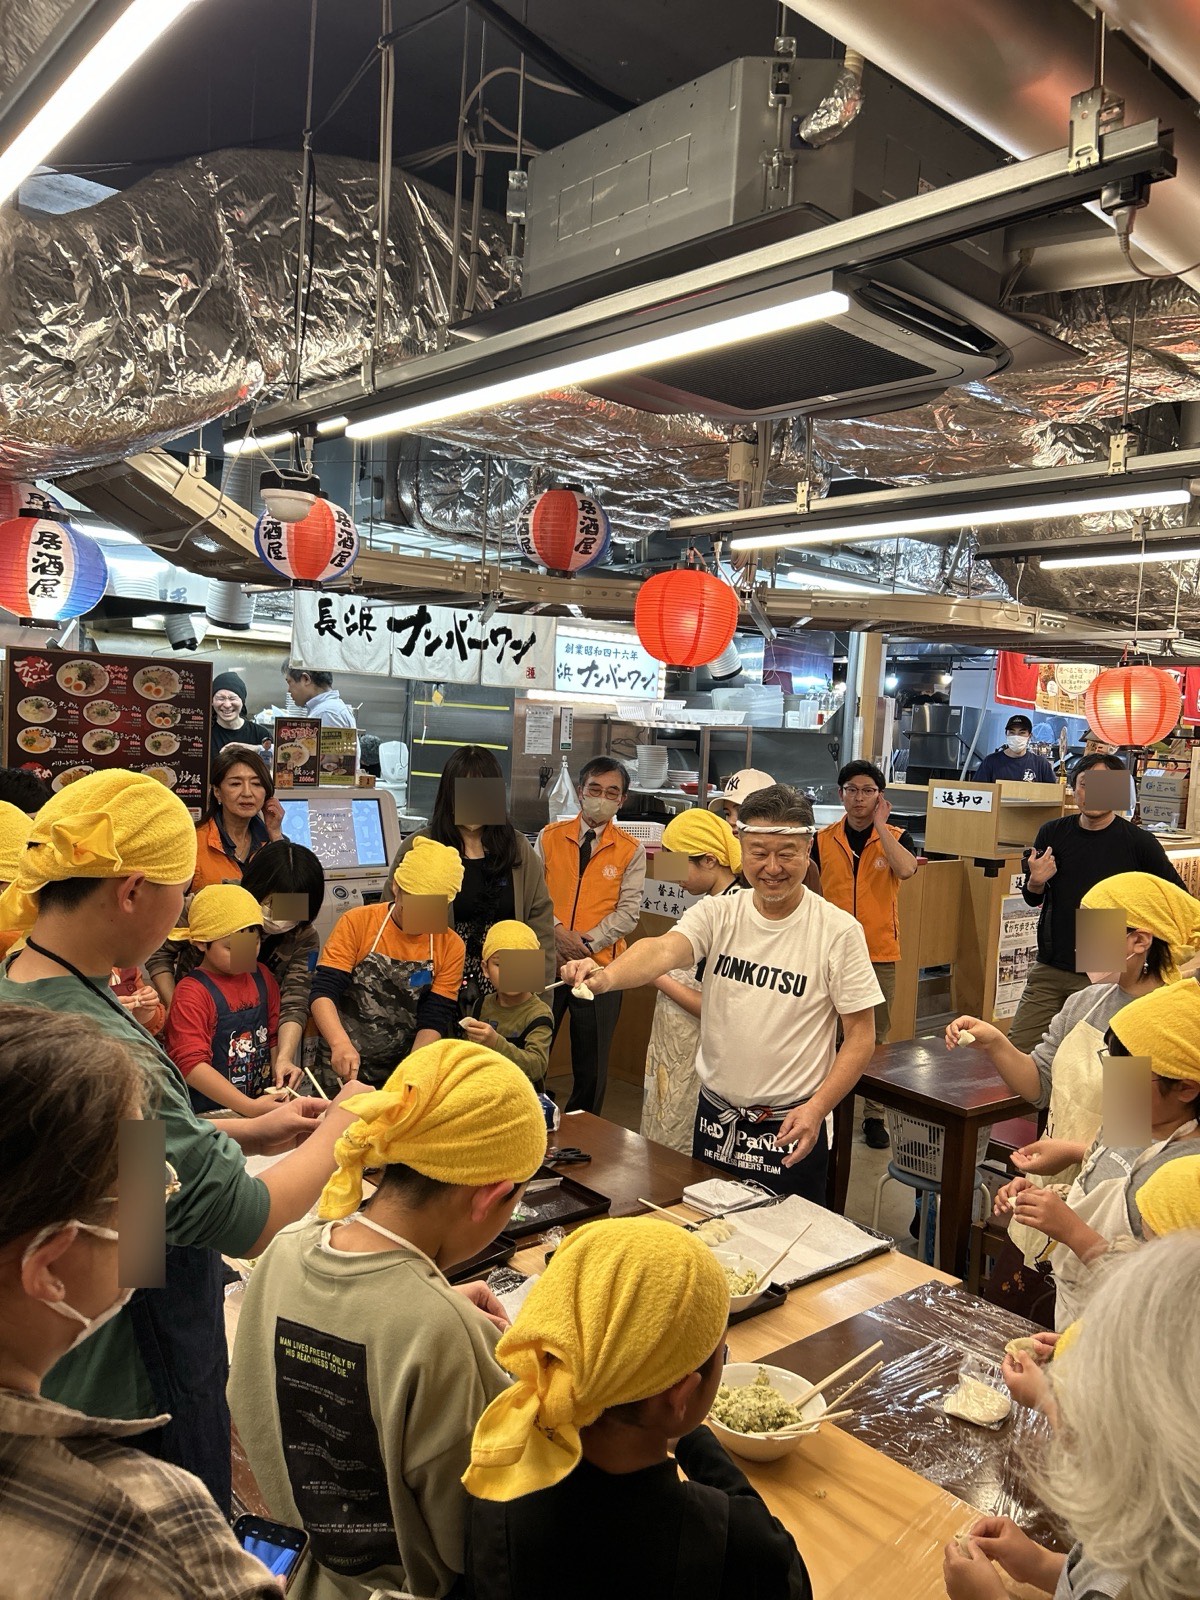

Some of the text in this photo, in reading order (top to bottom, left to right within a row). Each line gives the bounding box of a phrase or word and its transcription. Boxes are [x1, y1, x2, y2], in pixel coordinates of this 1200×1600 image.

[330, 510, 355, 568] 居酒屋
[574, 500, 600, 555] 居酒屋
[263, 520, 287, 560] 酒屋
[29, 531, 65, 598] 居酒屋
[564, 643, 639, 661] 創業昭和四十六年
[14, 660, 52, 676] ラーメン
[22, 672, 54, 688] メニュー
[178, 770, 202, 785] 炒飯
[942, 791, 983, 808] 返却口
[658, 884, 684, 899] 替玉は
[713, 954, 808, 998] TONKOTSU
[762, 1163, 781, 1176] TEAM
[280, 1336, 356, 1370] MAN LIVES FREELY ONLY BY
[285, 1348, 349, 1378] HIS READINESS TO DIE.
